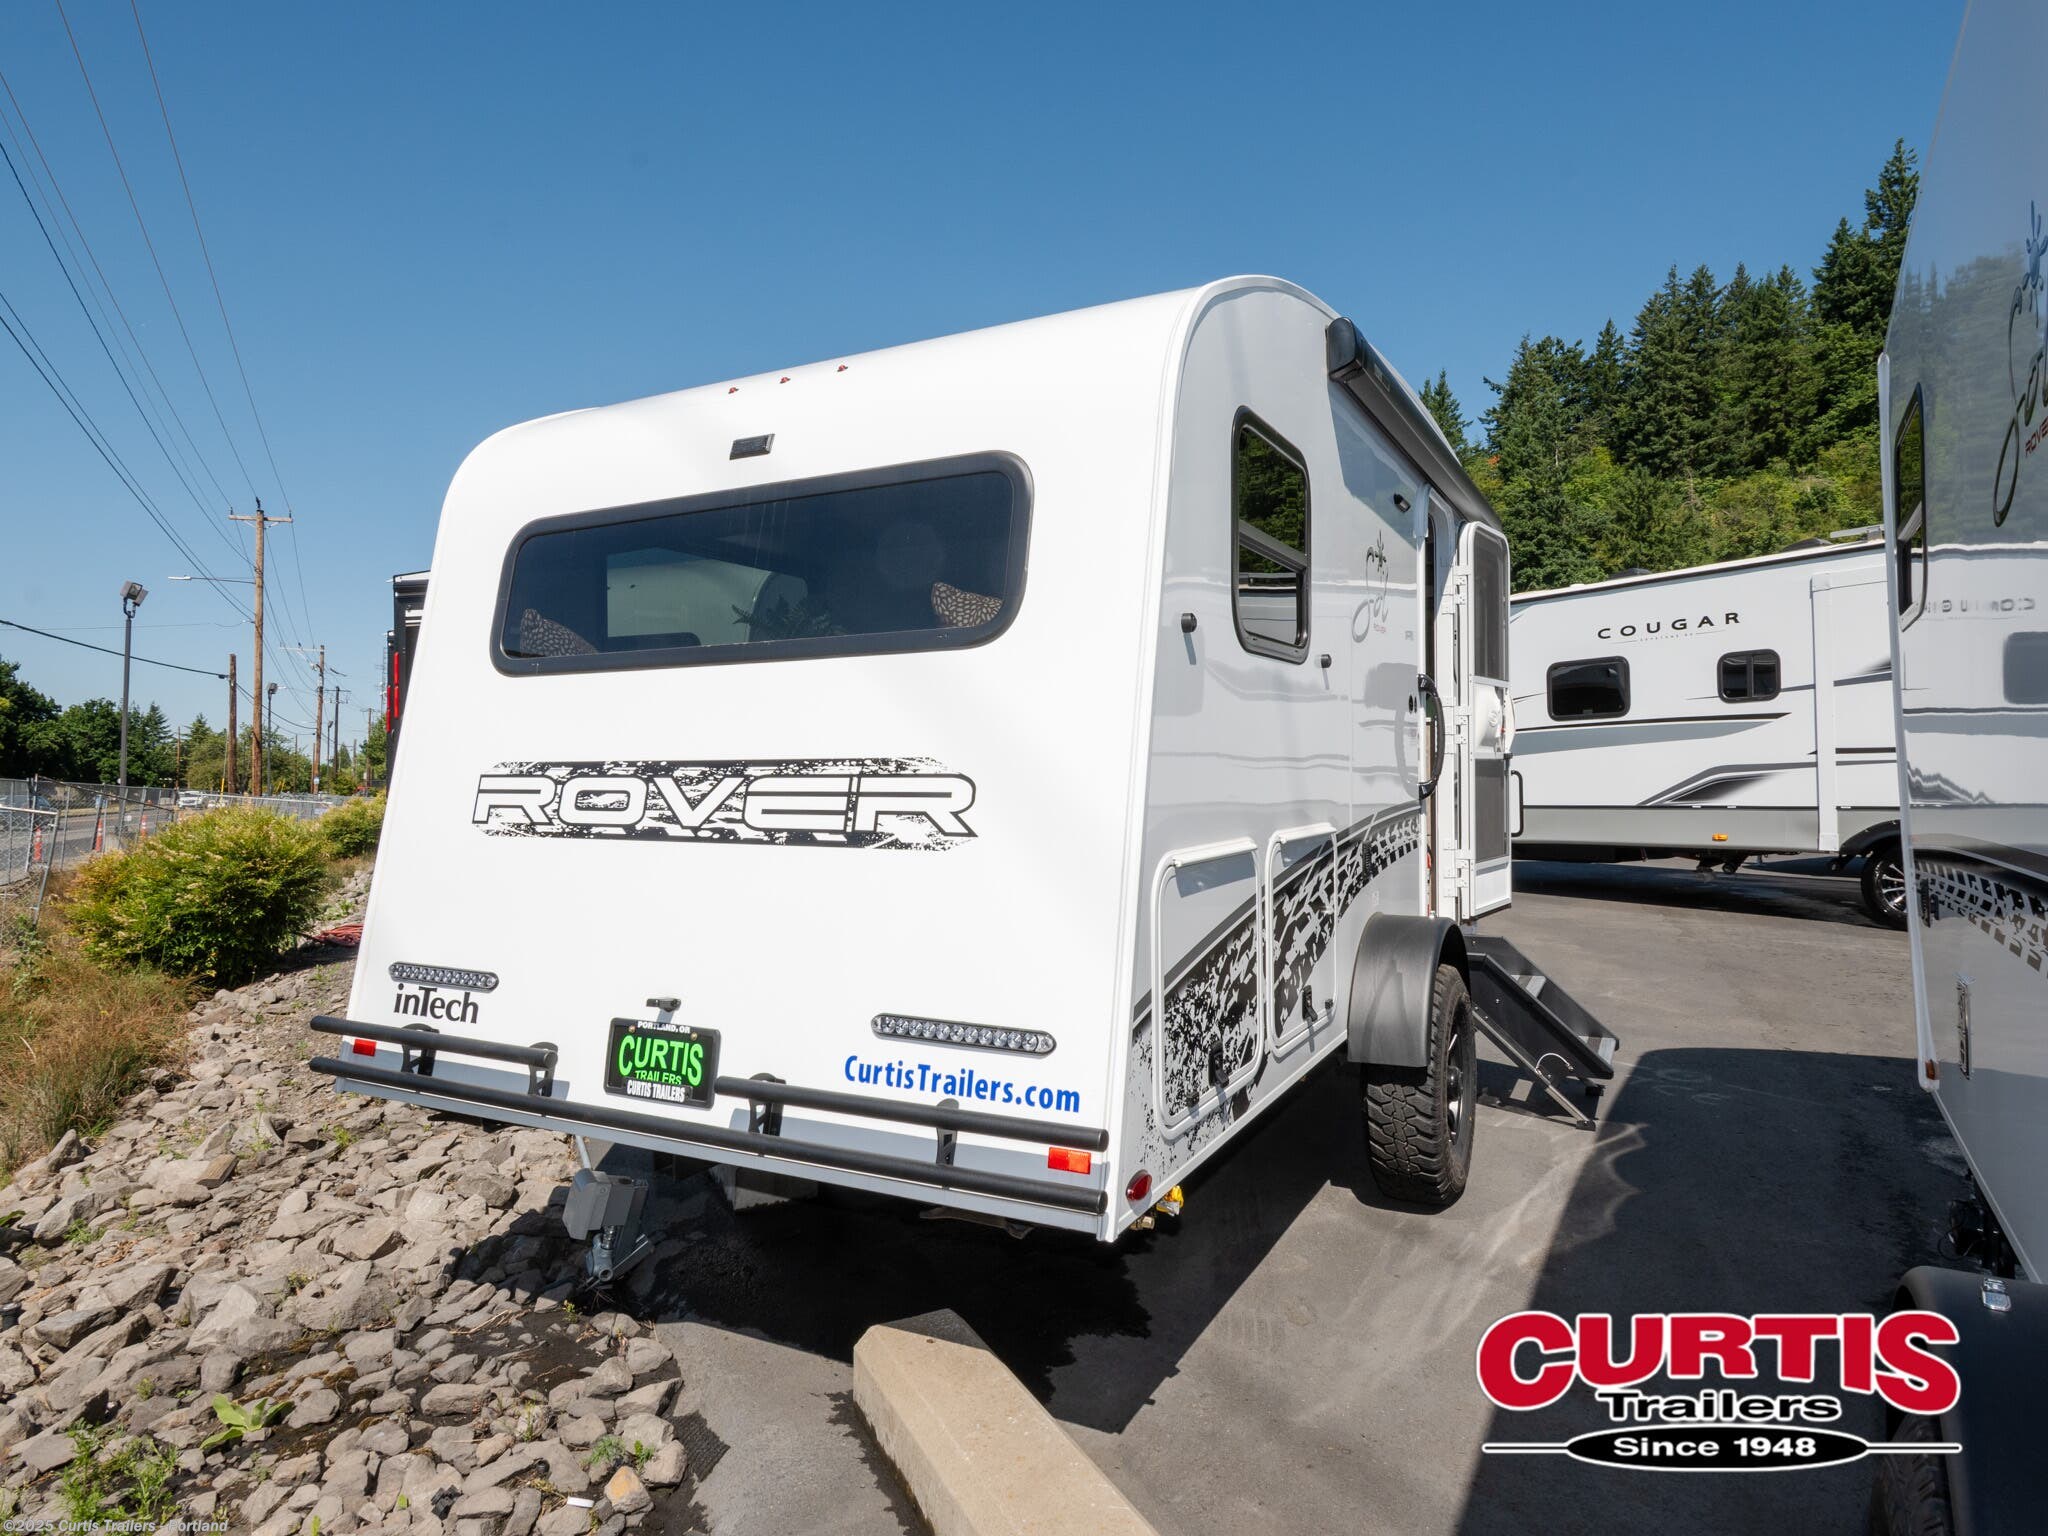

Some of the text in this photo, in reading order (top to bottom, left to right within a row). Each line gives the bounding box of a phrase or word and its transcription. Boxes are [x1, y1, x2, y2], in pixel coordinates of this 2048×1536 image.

[1597, 612, 1740, 640] COUGAR
[471, 773, 978, 838] ROVER
[393, 983, 479, 1024] inTech
[618, 1034, 704, 1087] CURTIS
[635, 1070, 682, 1085] TRAILERS
[627, 1079, 686, 1102] CURTIS TRAILERS
[844, 1055, 1080, 1113] CurtisTrailers.com
